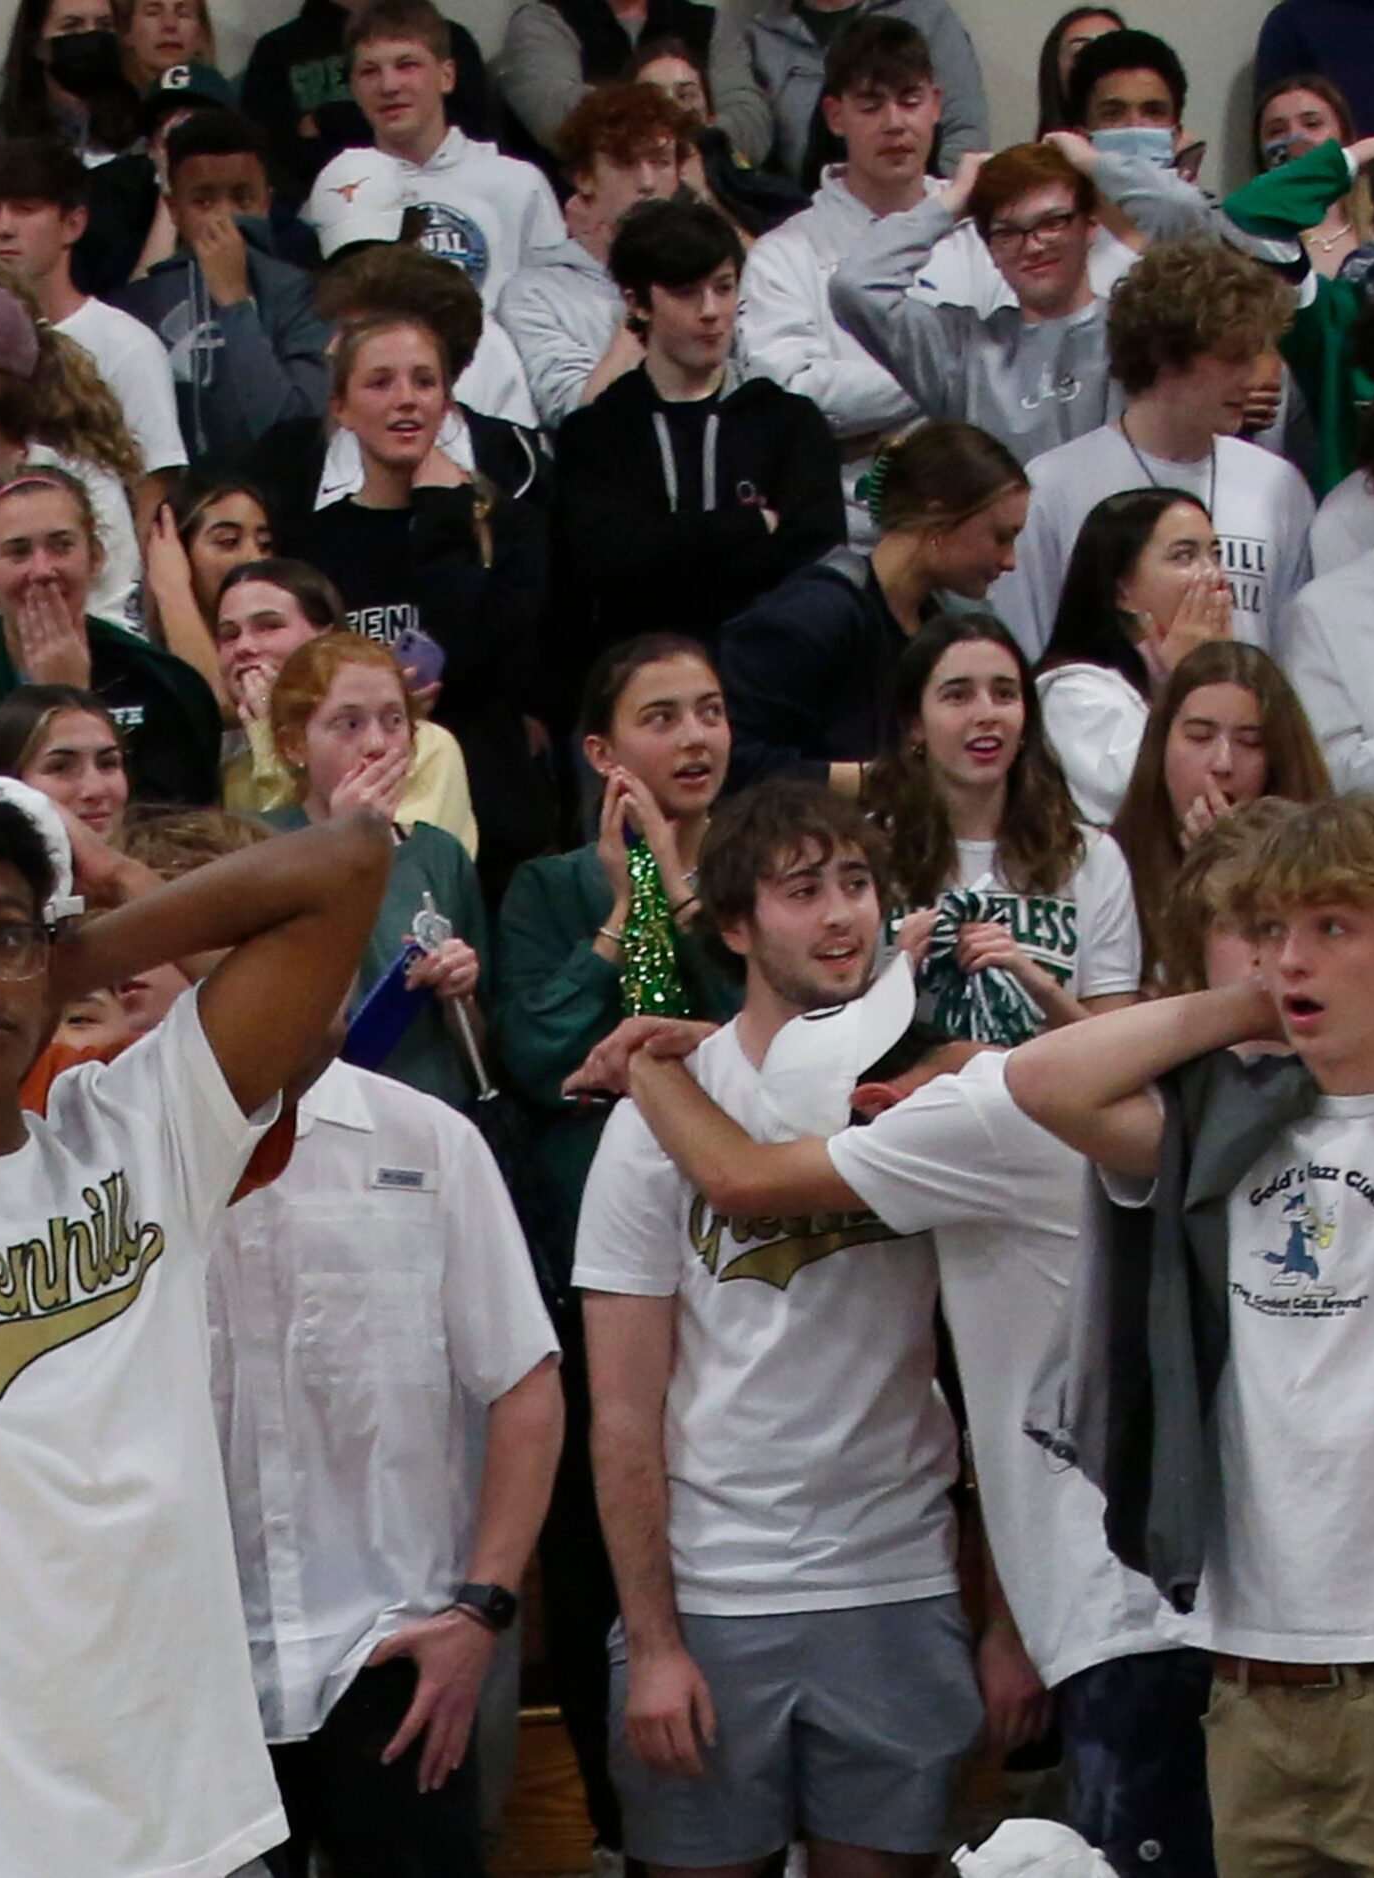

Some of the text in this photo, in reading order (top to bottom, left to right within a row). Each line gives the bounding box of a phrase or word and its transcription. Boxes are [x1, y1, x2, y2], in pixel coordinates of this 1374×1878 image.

[160, 64, 192, 90] G
[1215, 541, 1265, 573] ILL
[1249, 1166, 1306, 1207] Gold's
